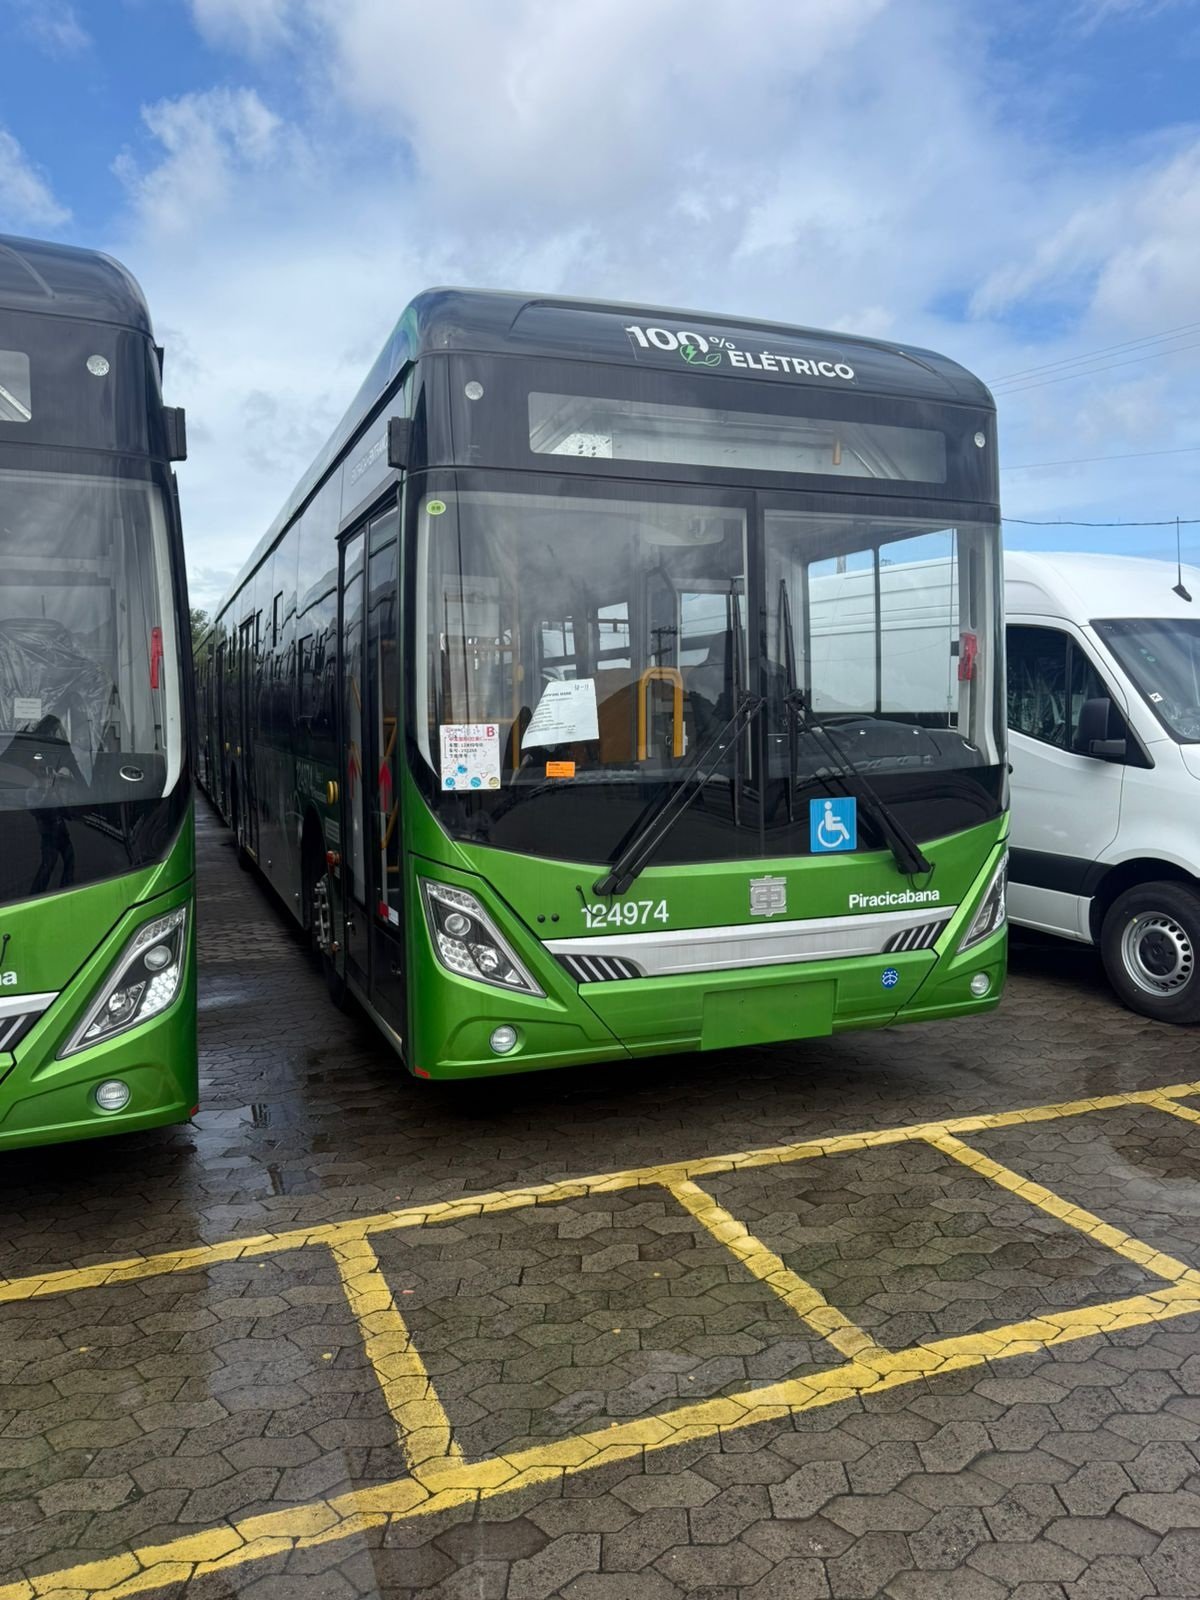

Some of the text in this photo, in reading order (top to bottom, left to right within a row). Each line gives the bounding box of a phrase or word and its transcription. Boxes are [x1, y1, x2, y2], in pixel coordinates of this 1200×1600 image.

[728, 350, 855, 380] ELÉTRICO
[486, 726, 495, 737] B
[848, 888, 941, 909] Piracicabana
[581, 899, 670, 928] 124974
